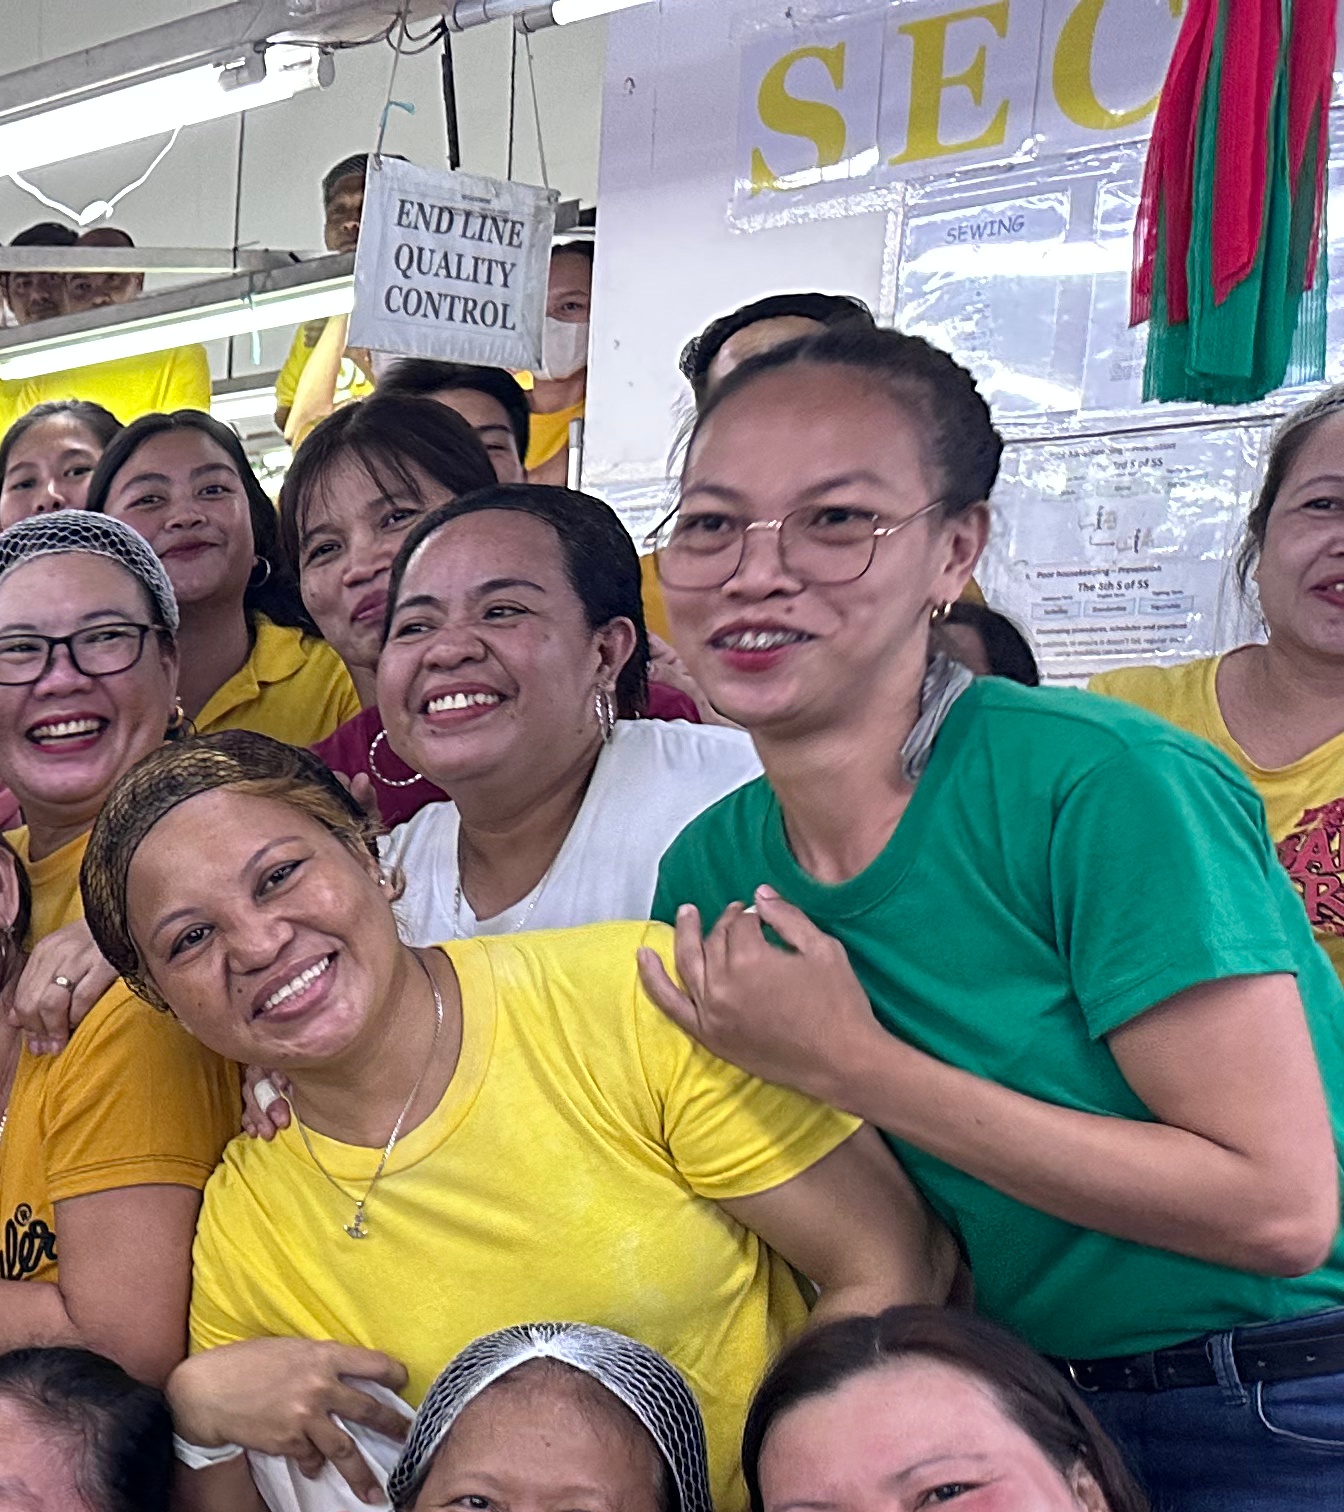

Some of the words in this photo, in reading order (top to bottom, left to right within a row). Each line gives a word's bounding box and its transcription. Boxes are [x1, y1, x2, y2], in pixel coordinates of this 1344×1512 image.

[396, 198, 454, 235] END
[459, 209, 524, 249] LINE
[946, 215, 1025, 245] SEWING
[394, 243, 517, 288] QUALITY
[384, 284, 517, 331] CONTROL
